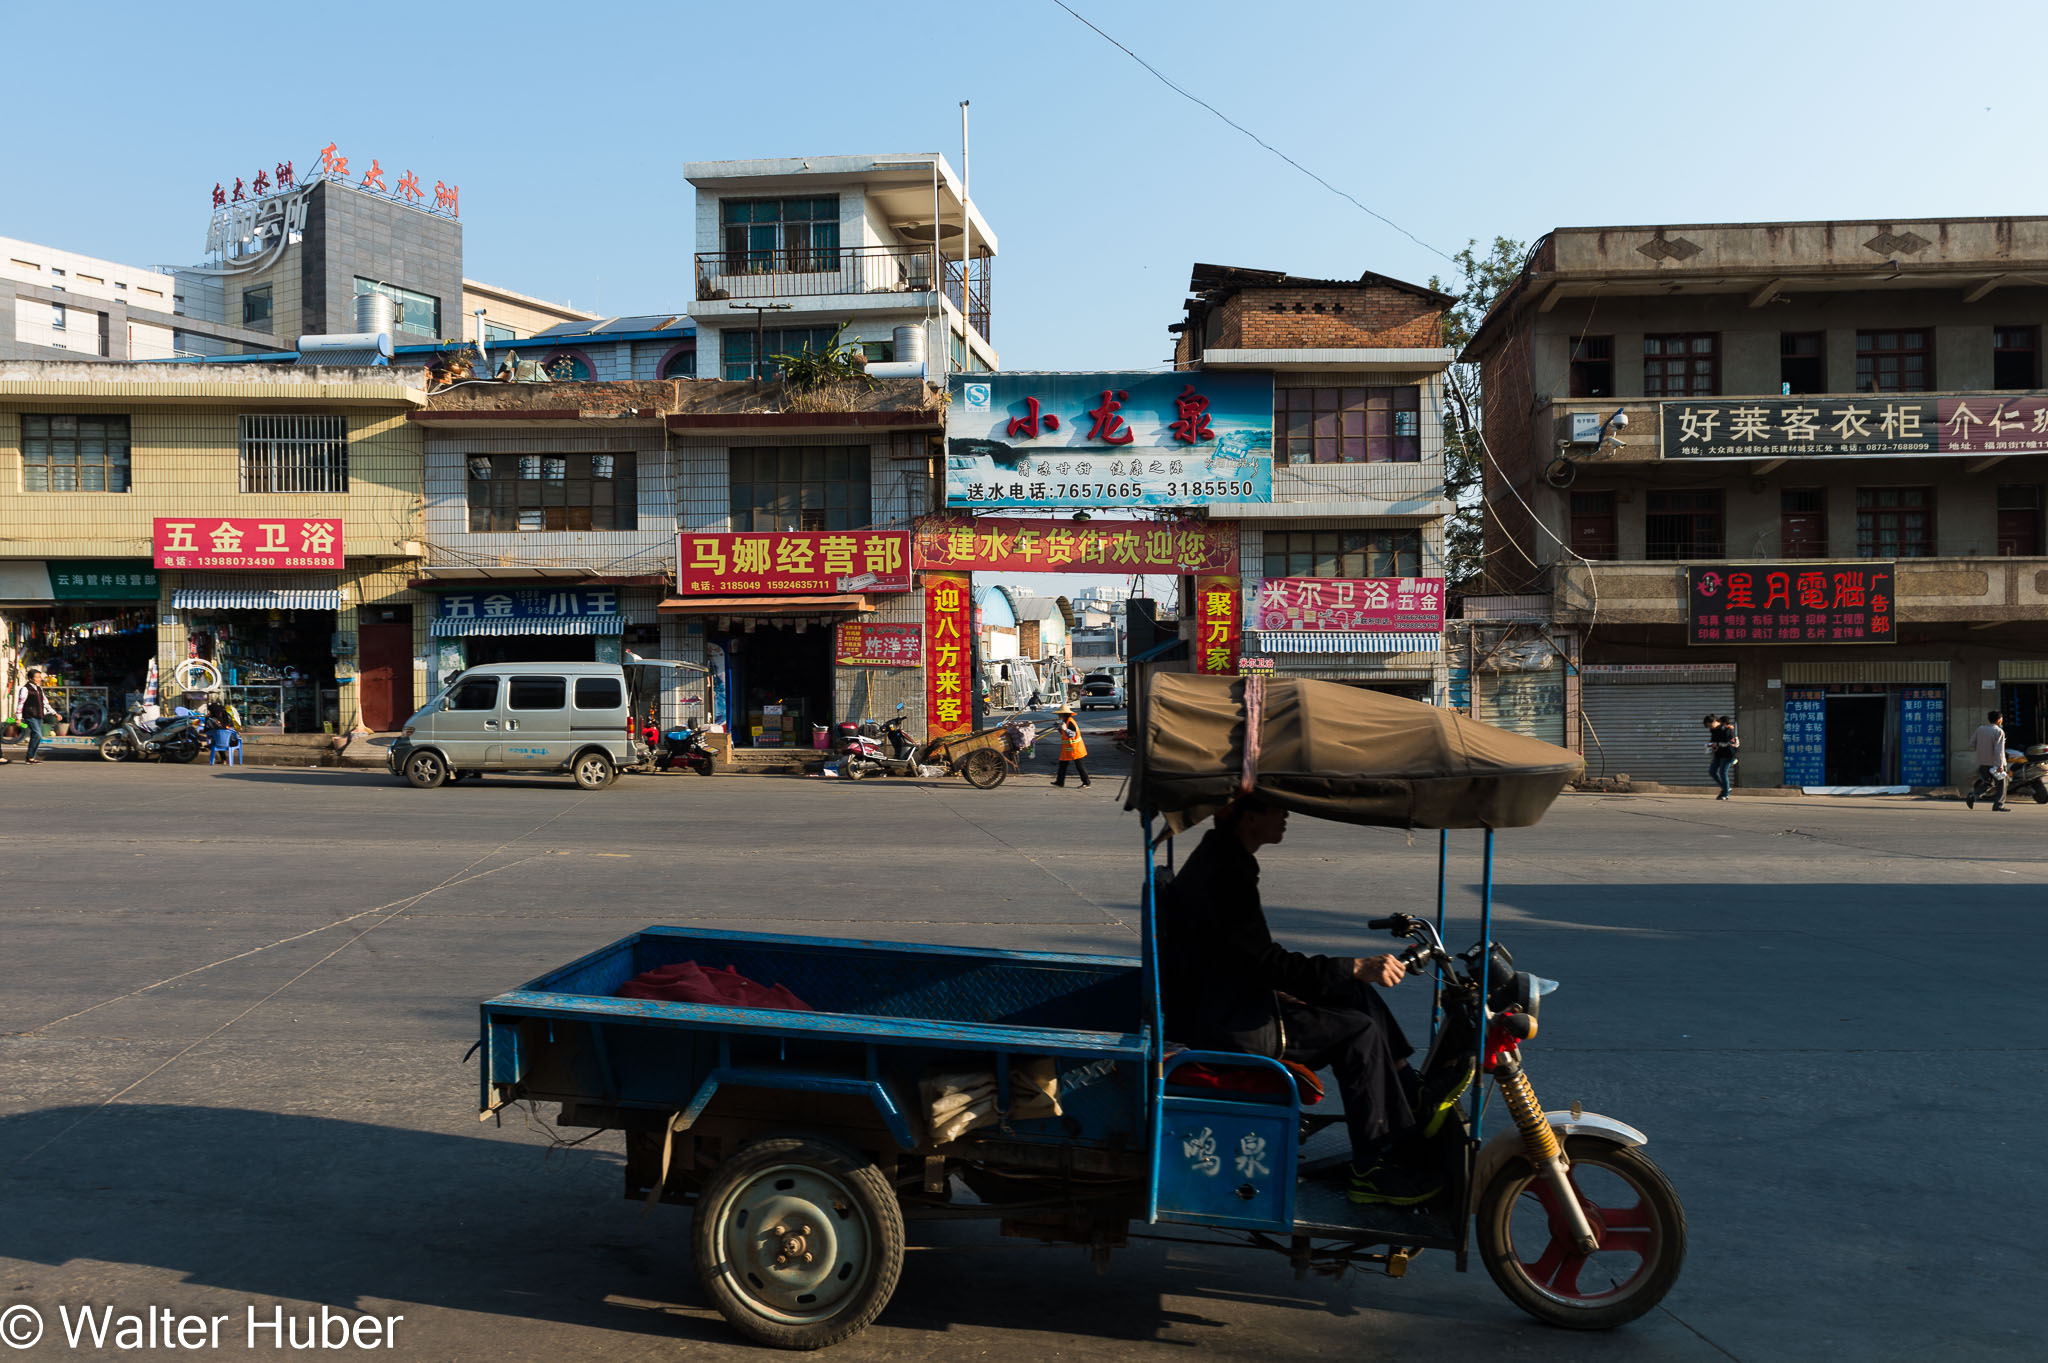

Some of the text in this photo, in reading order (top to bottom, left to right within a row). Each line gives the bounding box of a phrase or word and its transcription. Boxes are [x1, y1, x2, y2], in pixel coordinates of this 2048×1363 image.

[1007, 384, 1215, 444] 小龙泉
[1678, 404, 1923, 442] 好莱客衣柜
[1866, 443, 1929, 452] 0873-7688099
[1109, 459, 1183, 476] 健康之源
[1167, 480, 1253, 497] 3185550
[163, 521, 336, 554] 五金卫浴
[947, 526, 1207, 566] 建水年货街欢迎您
[198, 557, 275, 566] 13988073490
[285, 557, 335, 566] 8885898
[690, 535, 902, 576] 马娜经营部
[720, 581, 760, 590] 3185049
[767, 580, 829, 590] 15924635711
[1263, 580, 1389, 610] 米尔卫浴
[1398, 594, 1438, 611] 五金
[1870, 573, 1889, 633] 广告部
[865, 636, 919, 657] 炸洋芋
[1205, 591, 1232, 675] 聚万家
[934, 588, 962, 723] 迎八方来客
